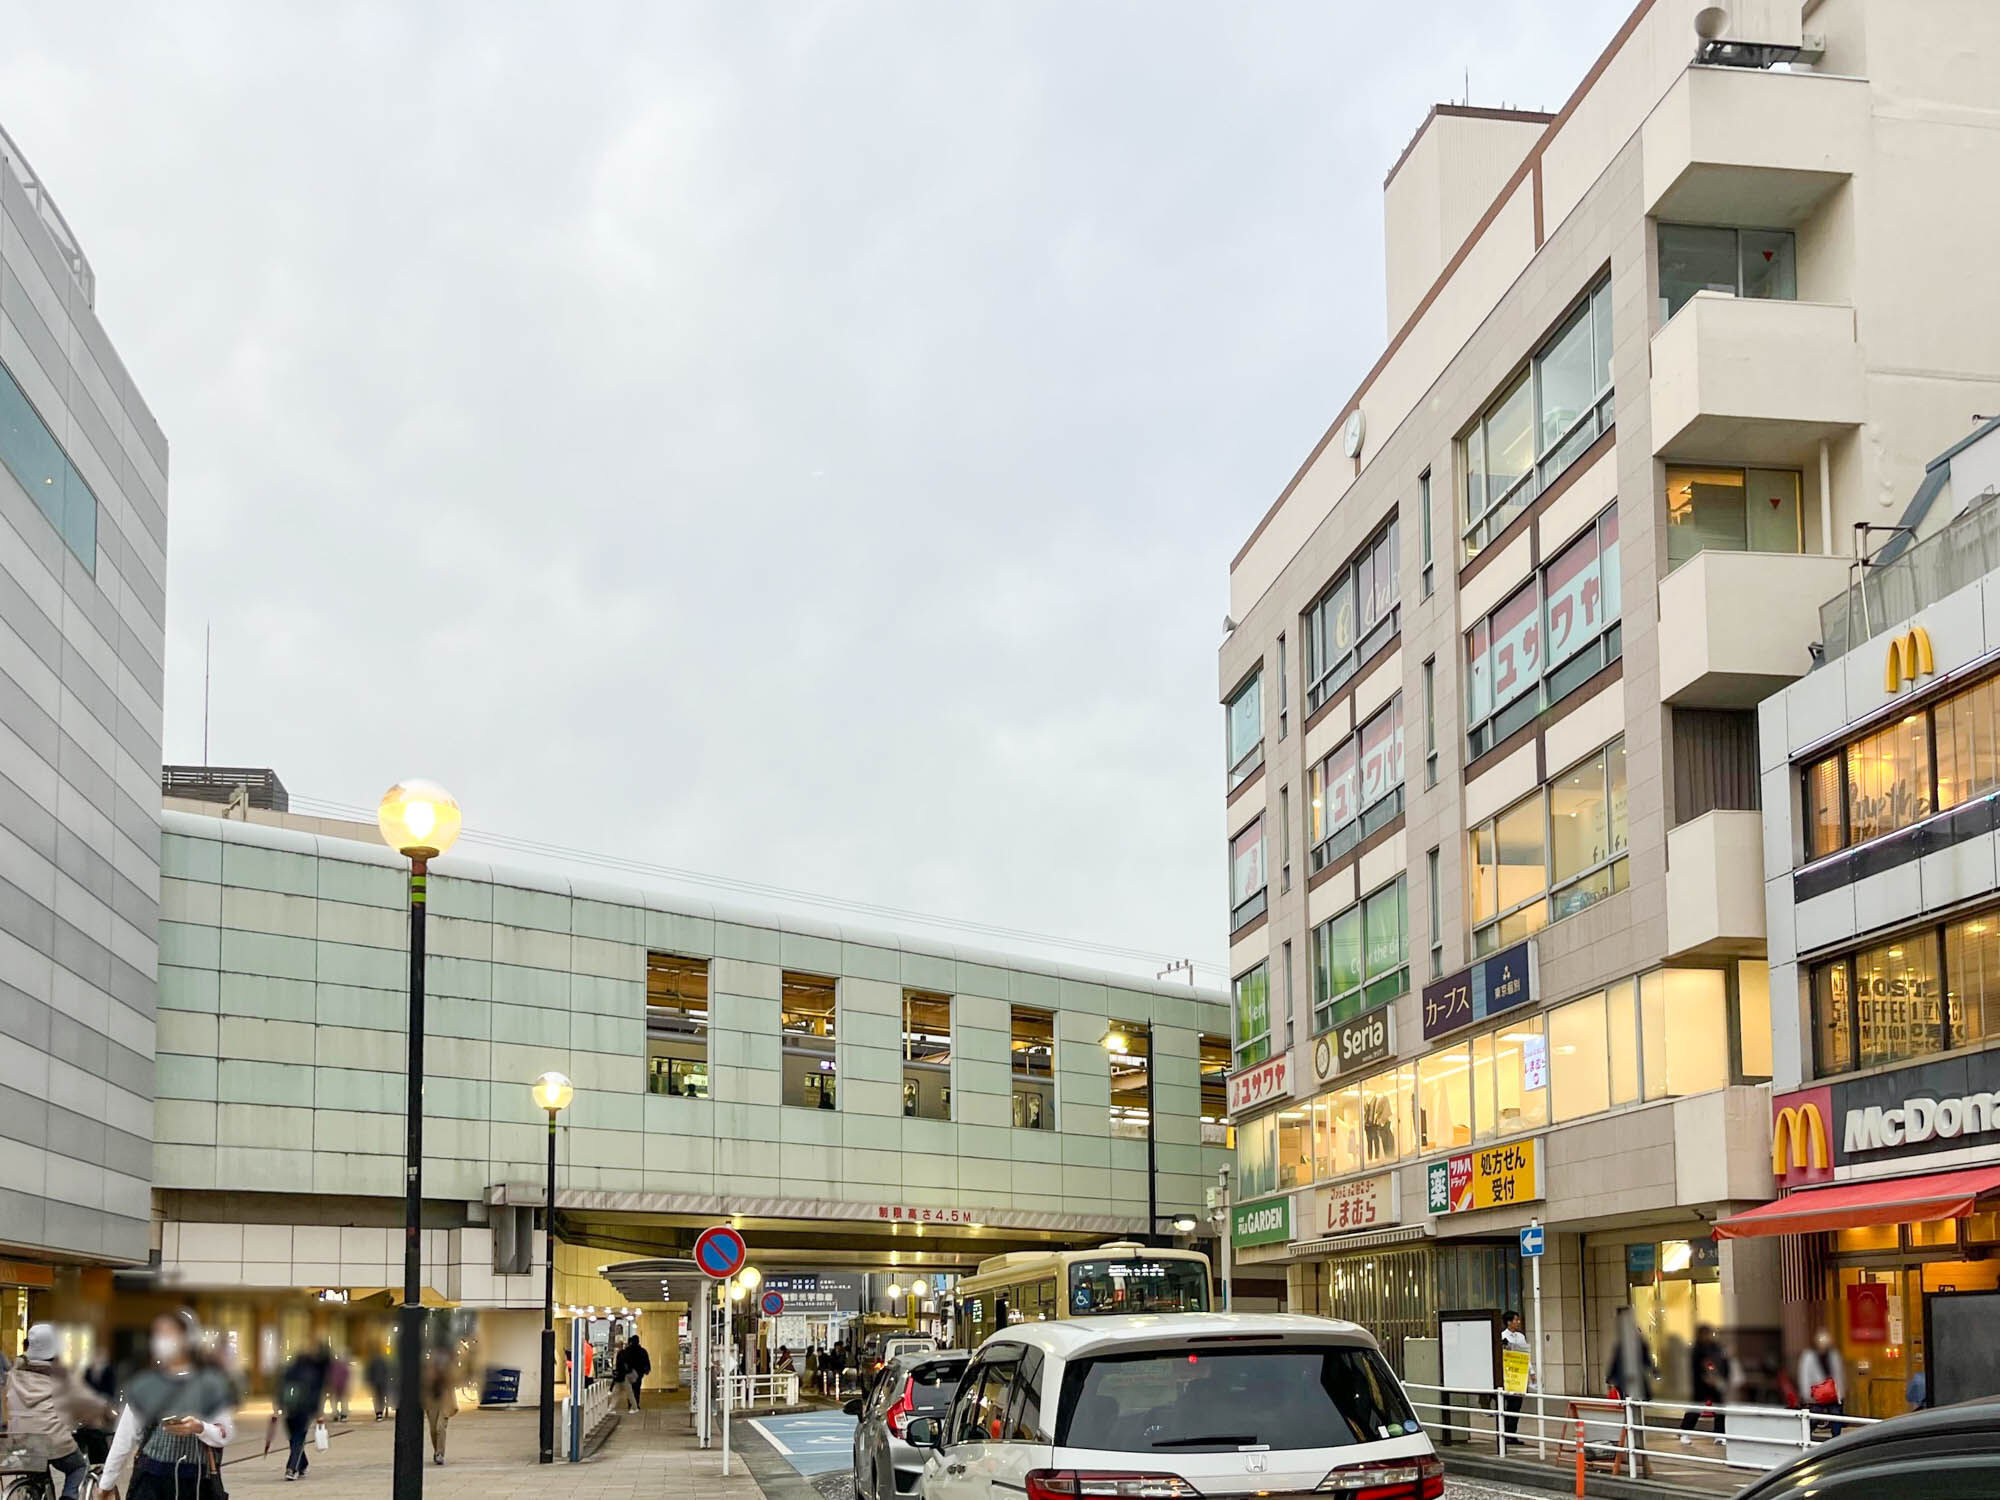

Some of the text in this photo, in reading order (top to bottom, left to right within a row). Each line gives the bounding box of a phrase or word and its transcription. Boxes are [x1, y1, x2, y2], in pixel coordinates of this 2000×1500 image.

[1342, 1015, 1384, 1060] Seria
[1450, 1158, 1472, 1176] ツルハ
[1481, 1146, 1526, 1177] 処方せん
[1430, 1167, 1447, 1208] 薬
[1450, 1176, 1468, 1188] ドラッグ
[1492, 1175, 1515, 1202] 受付
[1248, 1206, 1282, 1234] GARDEN
[1327, 1193, 1377, 1230] しまむら
